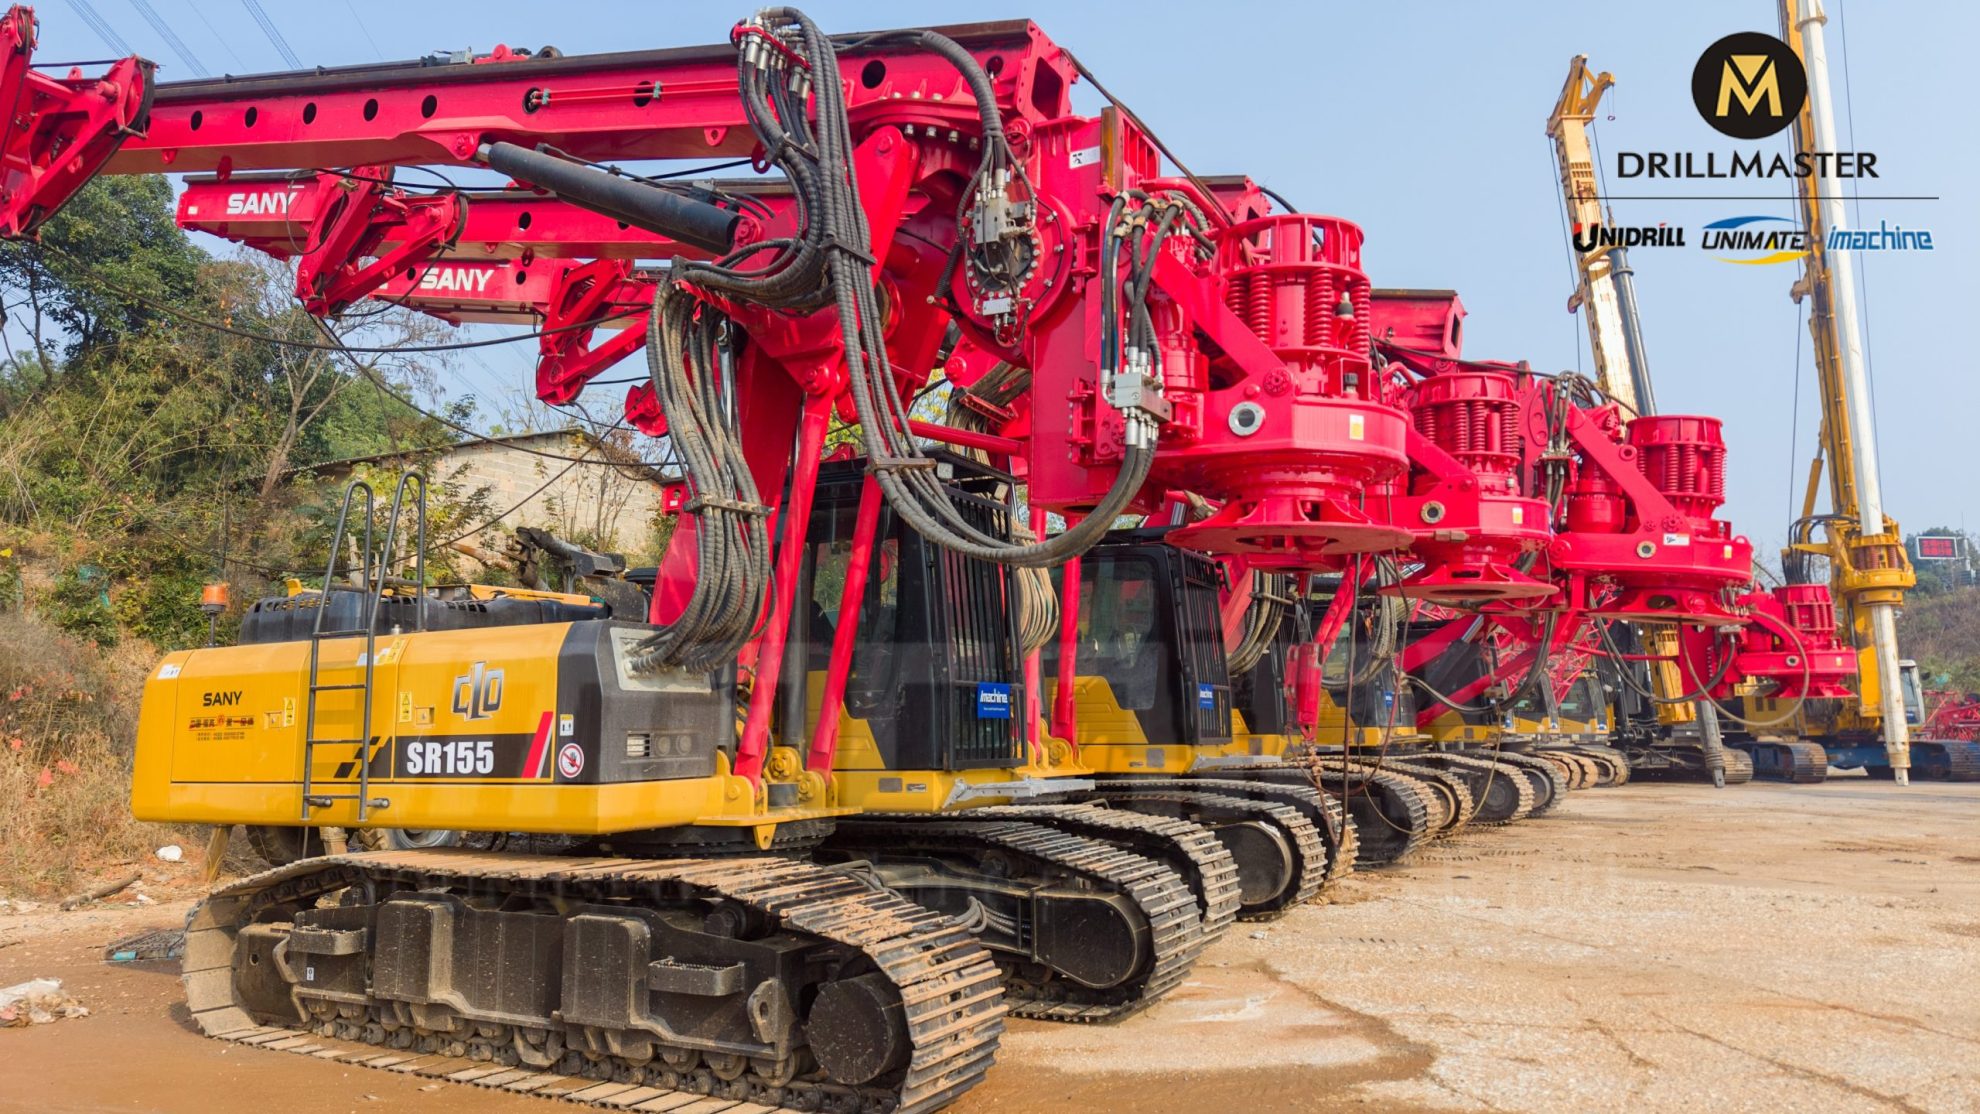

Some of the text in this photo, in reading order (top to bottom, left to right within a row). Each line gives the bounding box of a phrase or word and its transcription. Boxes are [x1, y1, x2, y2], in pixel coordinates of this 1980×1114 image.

[226, 192, 297, 214] SANY
[420, 268, 494, 291] SANY
[203, 691, 242, 706] SANY
[407, 741, 494, 774] SR155
